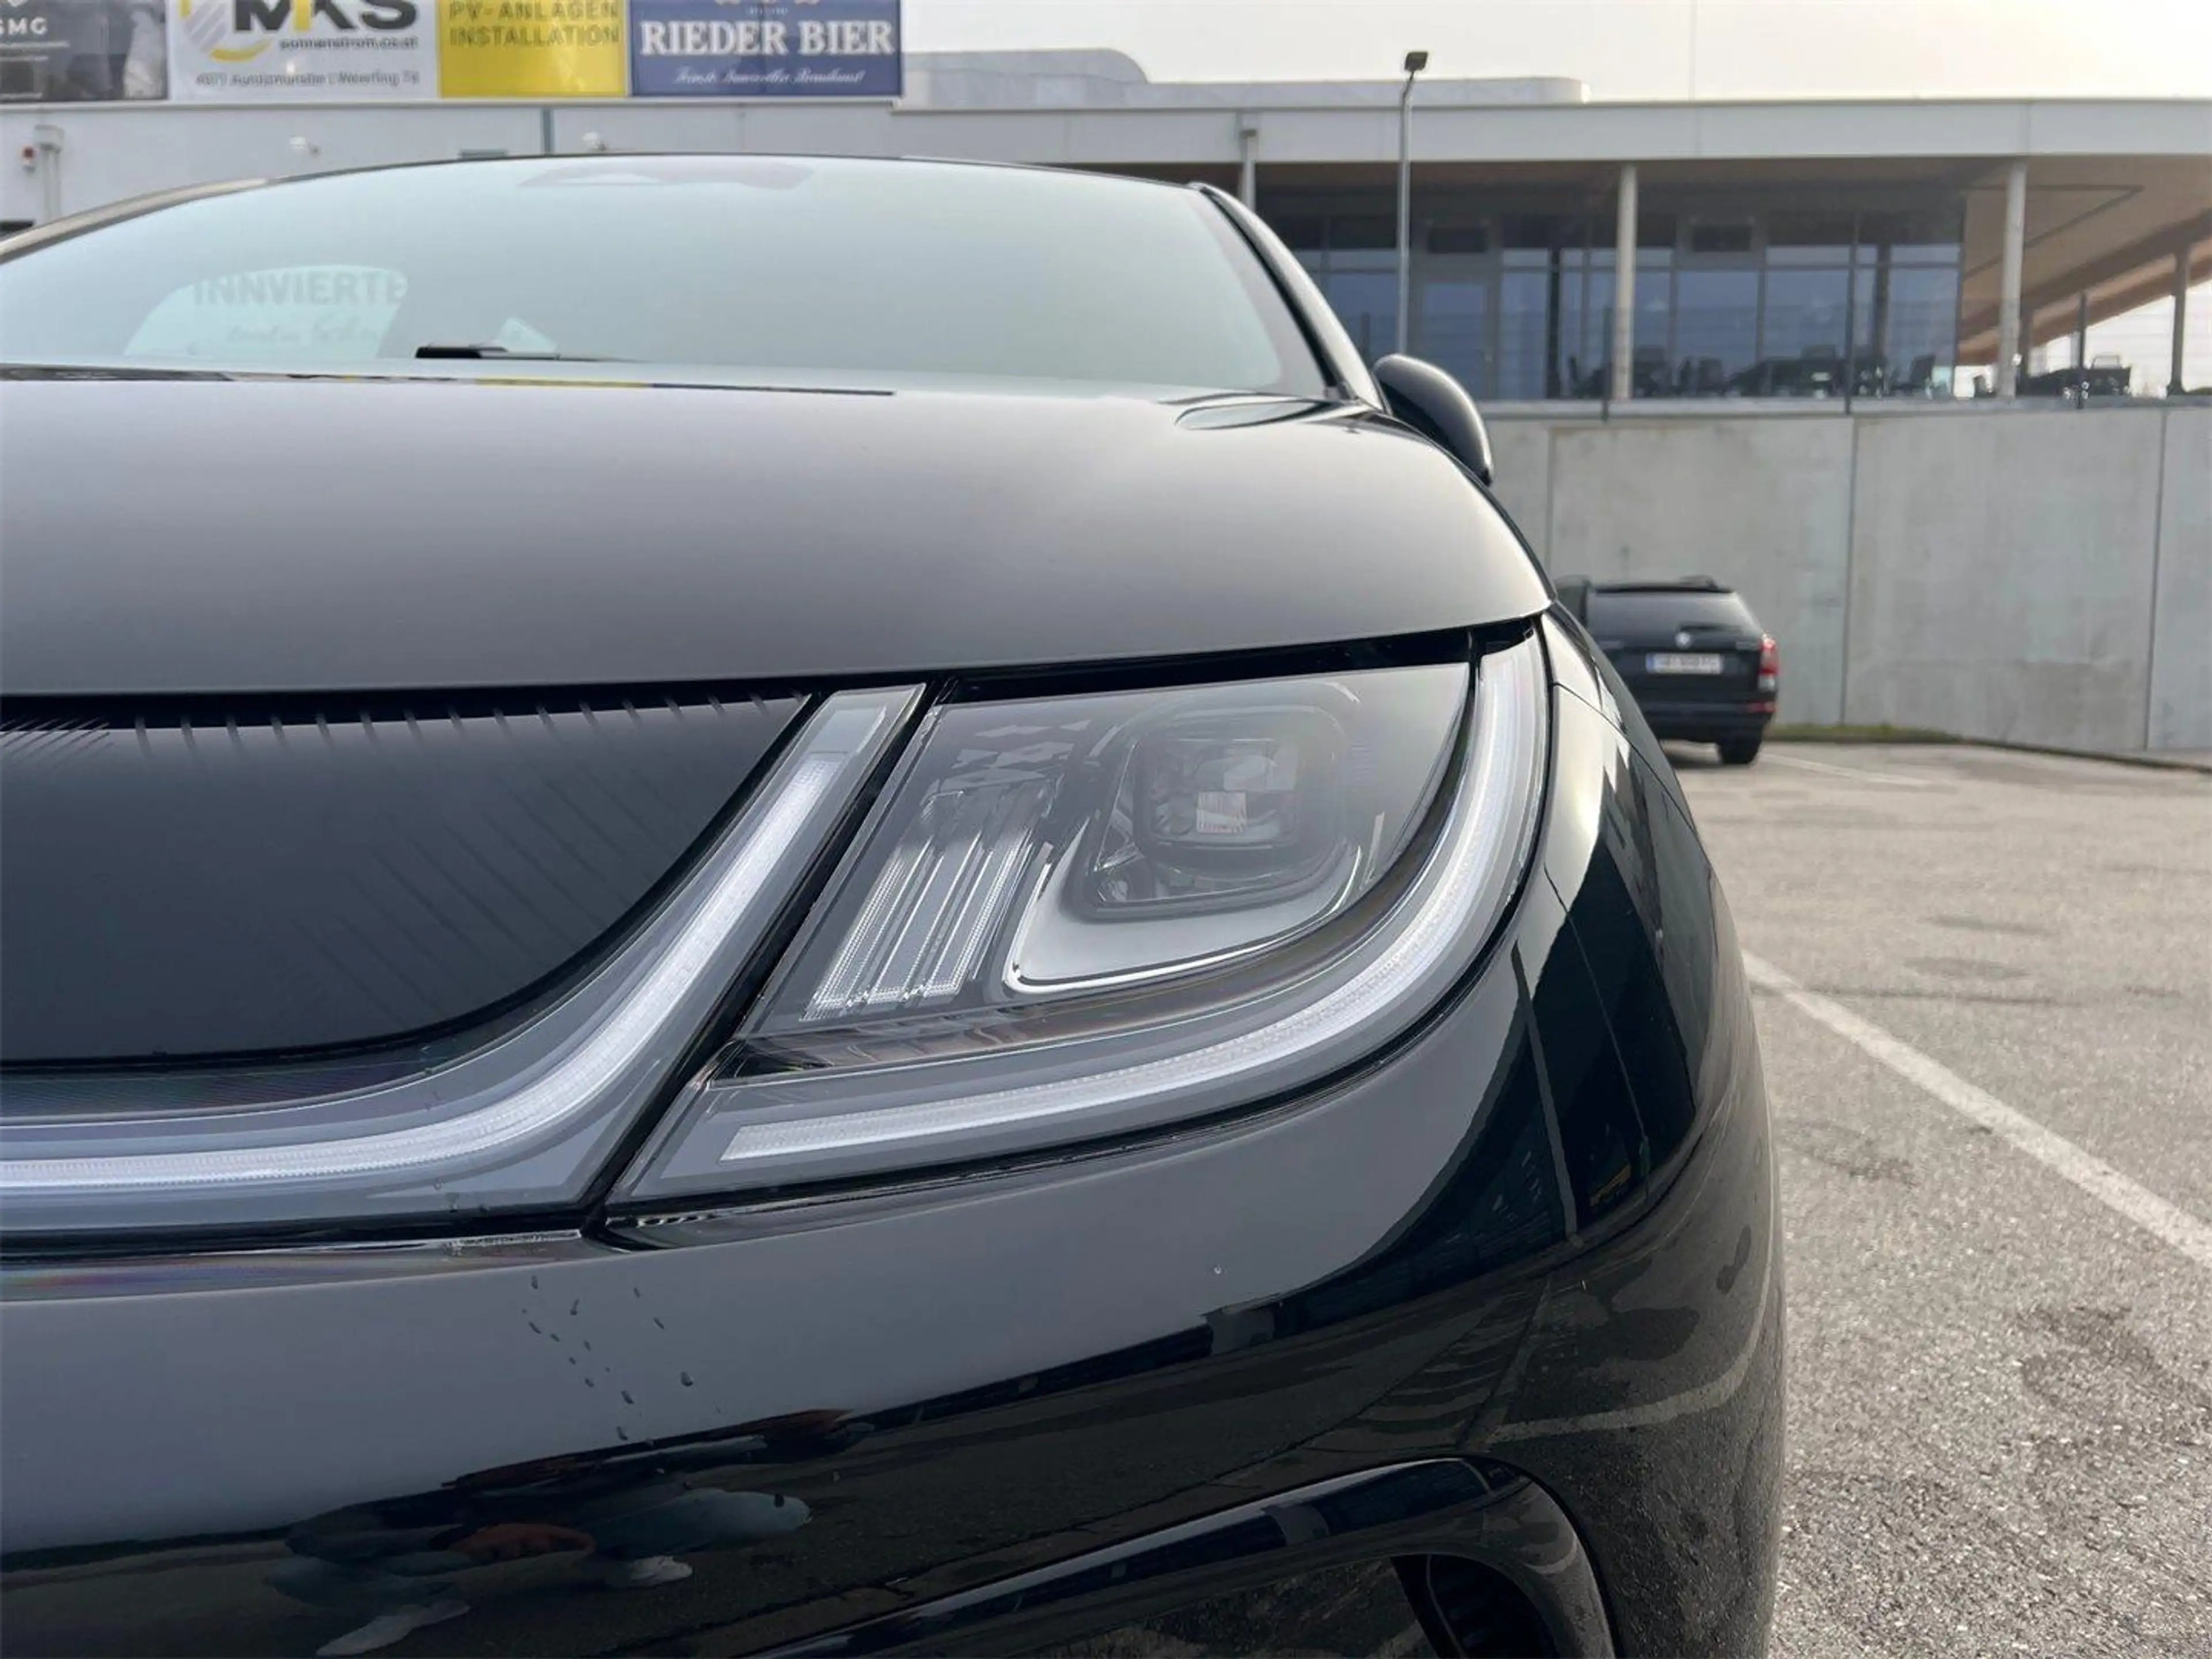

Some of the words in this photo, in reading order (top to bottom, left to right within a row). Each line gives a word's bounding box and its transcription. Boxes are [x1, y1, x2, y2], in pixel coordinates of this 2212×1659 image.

[449, 25, 621, 46] INSTALLATION
[639, 20, 789, 55] RIEDER
[797, 20, 895, 55] BIER
